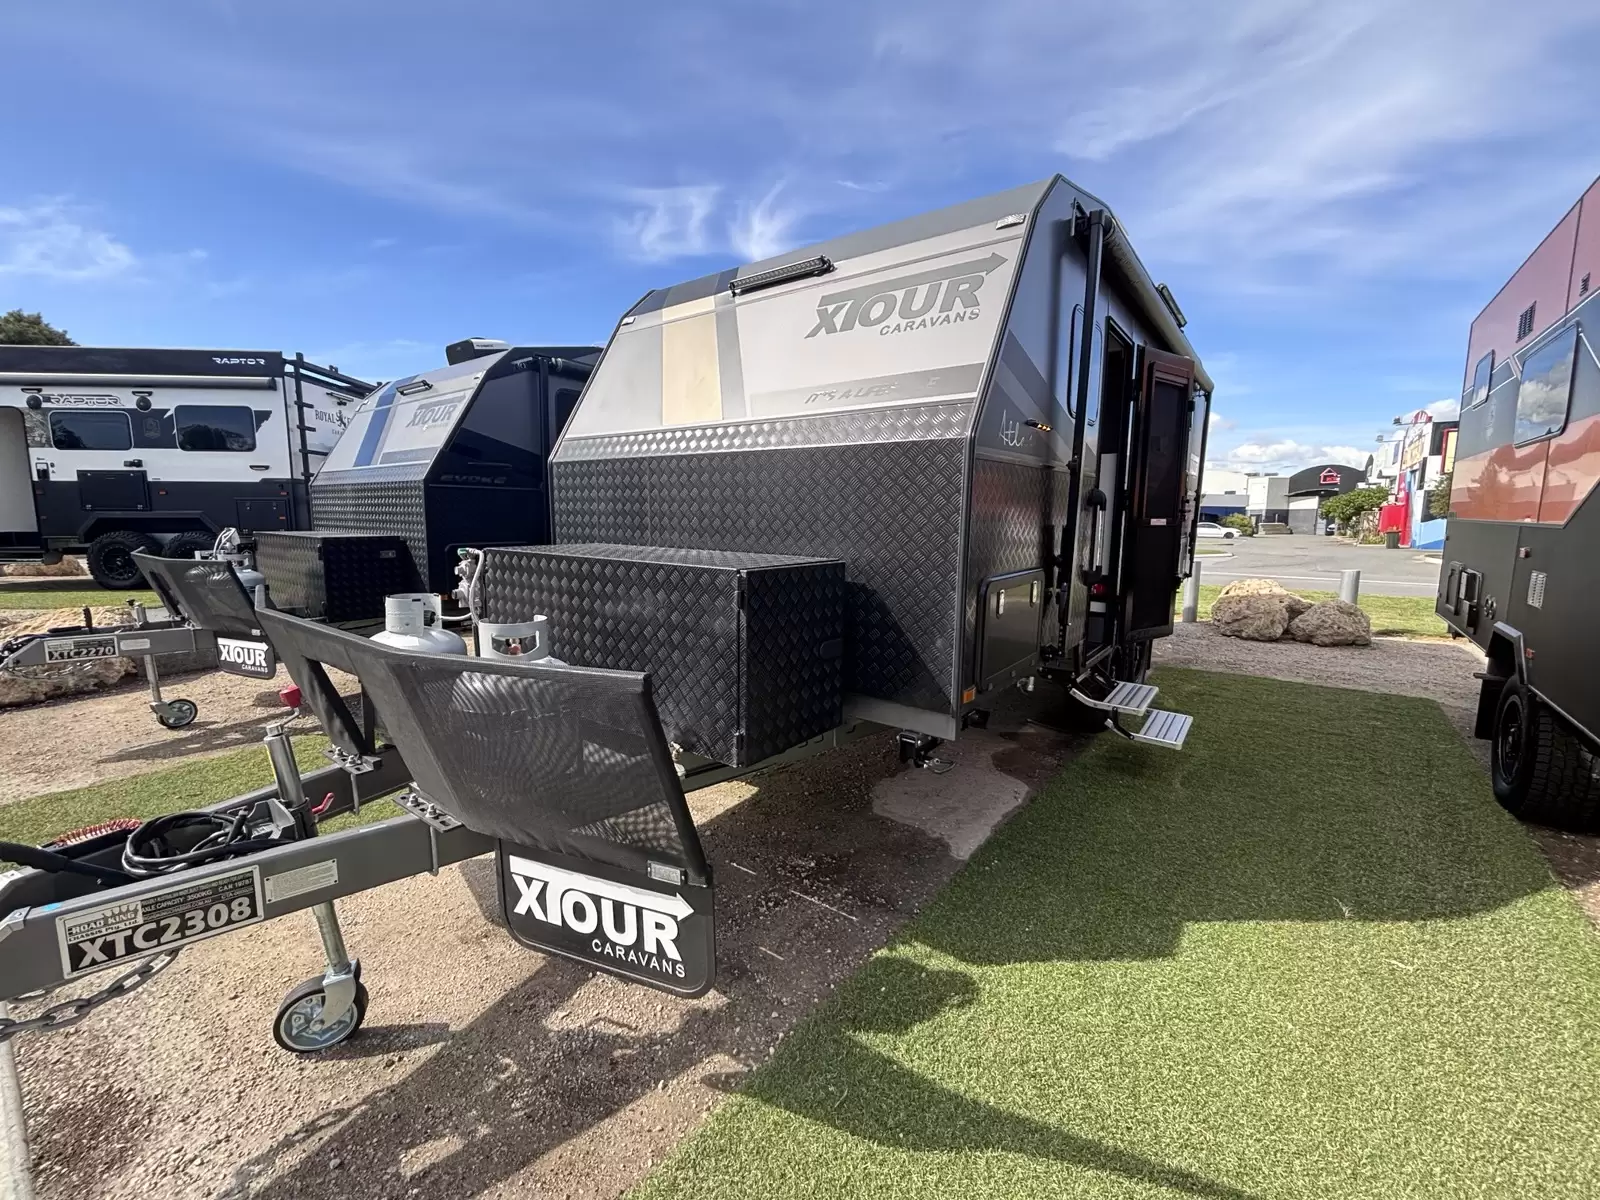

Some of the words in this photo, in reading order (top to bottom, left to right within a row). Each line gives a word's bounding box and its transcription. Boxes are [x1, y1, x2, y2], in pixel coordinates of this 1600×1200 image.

[804, 264, 990, 339] XTOUR
[879, 309, 980, 336] CARAVANS
[212, 357, 266, 365] RAPTOR
[315, 409, 336, 424] ROYAL
[52, 646, 114, 660] XTC2270
[218, 642, 268, 667] XTOUR
[72, 919, 104, 934] ROAD
[108, 911, 135, 925] KING
[510, 866, 684, 961] XTOUR
[78, 897, 251, 968] XTC2308
[592, 939, 686, 979] CARAVANS
